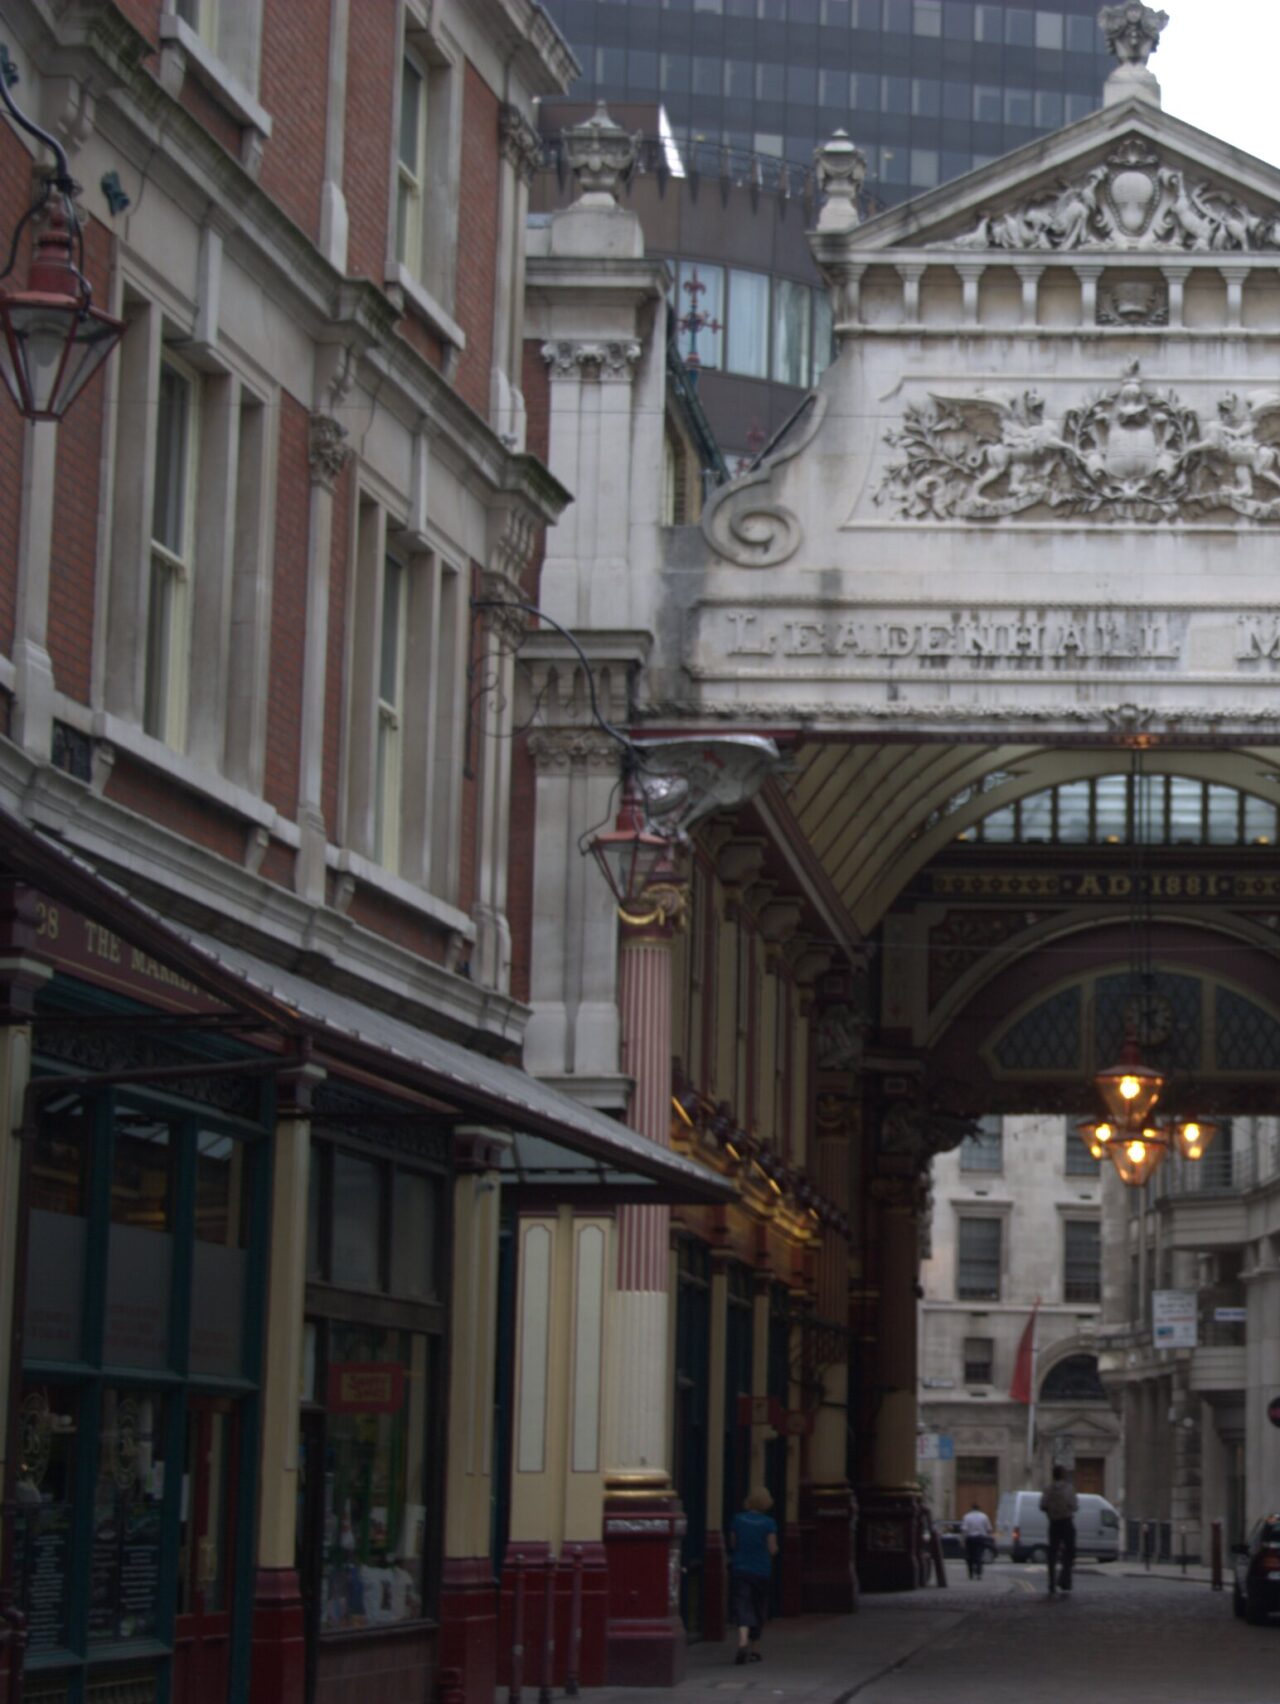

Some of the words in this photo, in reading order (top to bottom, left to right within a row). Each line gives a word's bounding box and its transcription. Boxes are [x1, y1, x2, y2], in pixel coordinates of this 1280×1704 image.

[724, 611, 1182, 662] LEADENHALL
[1151, 874, 1219, 896] 1881
[84, 920, 121, 963] THE
